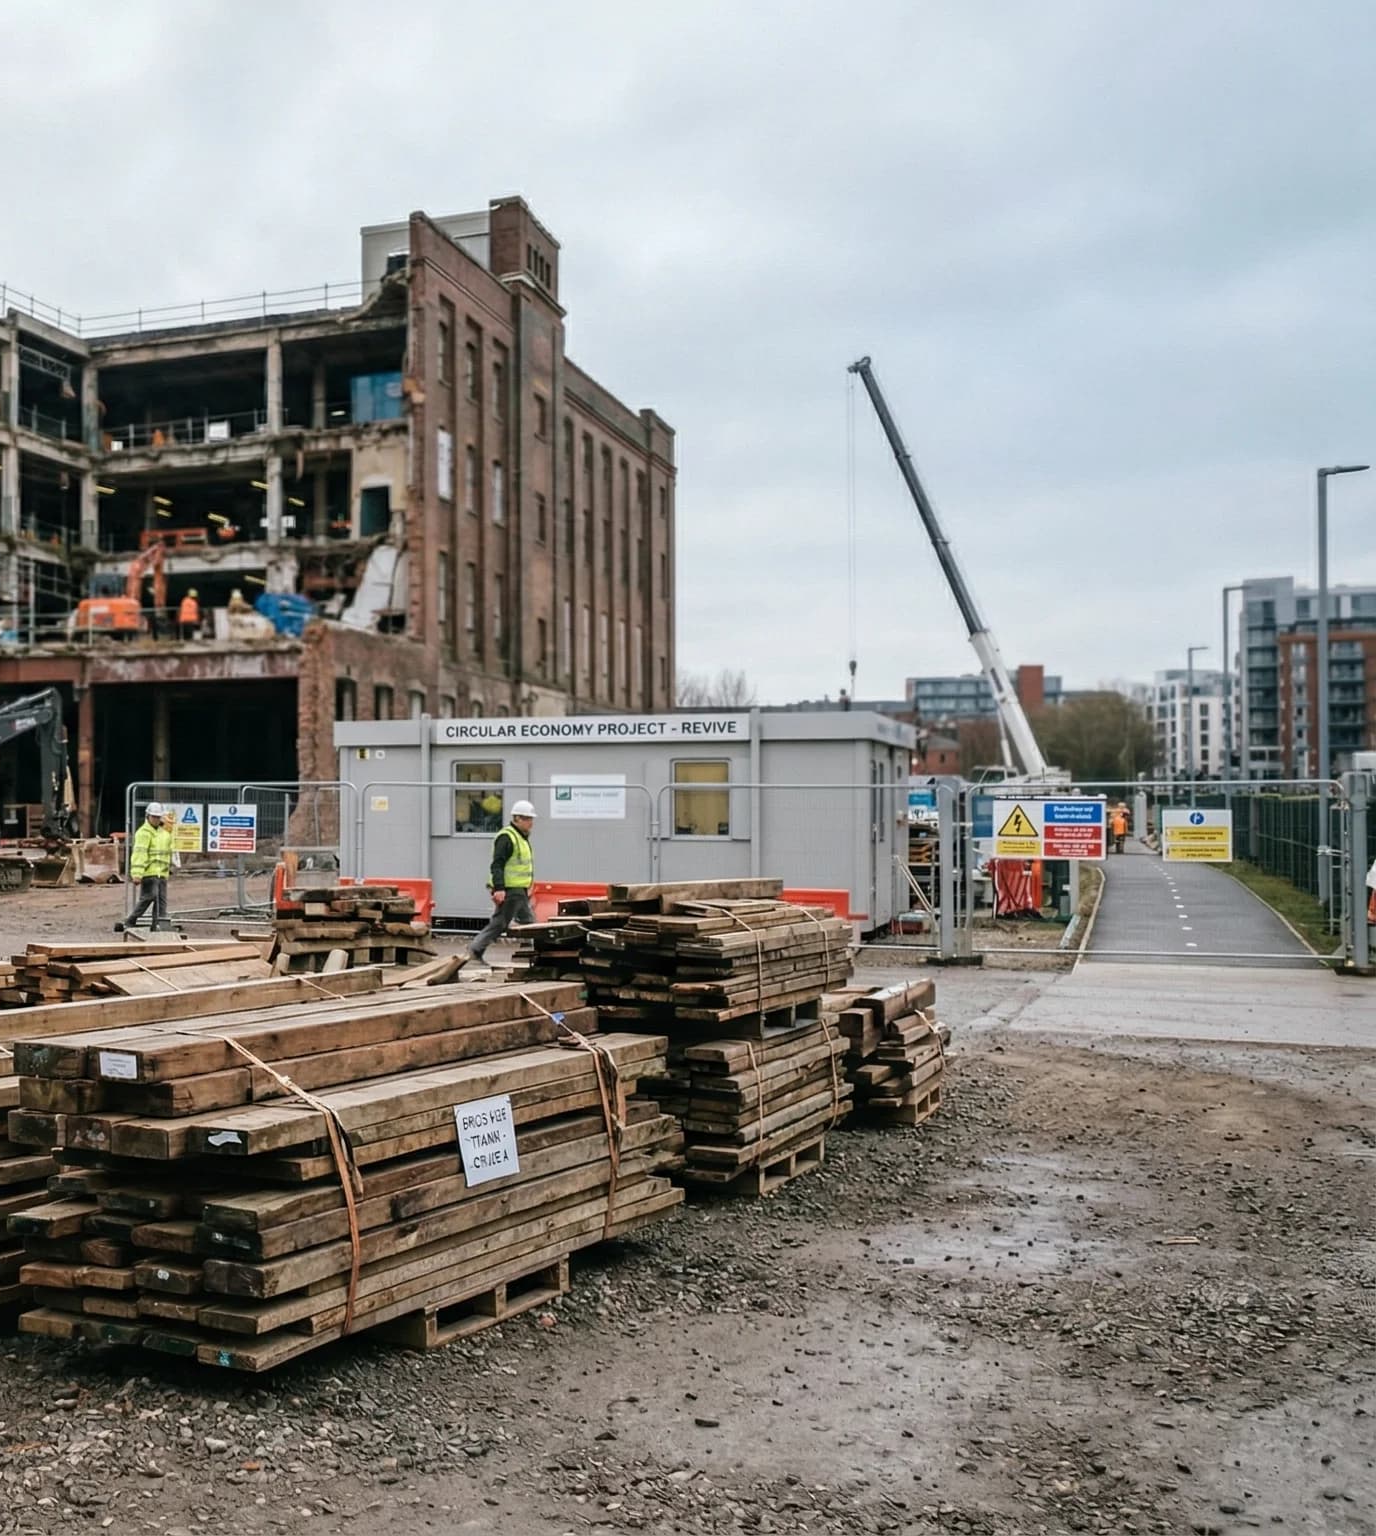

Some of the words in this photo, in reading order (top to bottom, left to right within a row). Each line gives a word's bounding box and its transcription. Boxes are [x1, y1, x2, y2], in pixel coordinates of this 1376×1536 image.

[446, 725, 516, 737] CIRCULAR
[521, 724, 593, 737] ECONOMY
[597, 722, 667, 735] PROJECT
[681, 721, 736, 734] REVIVE
